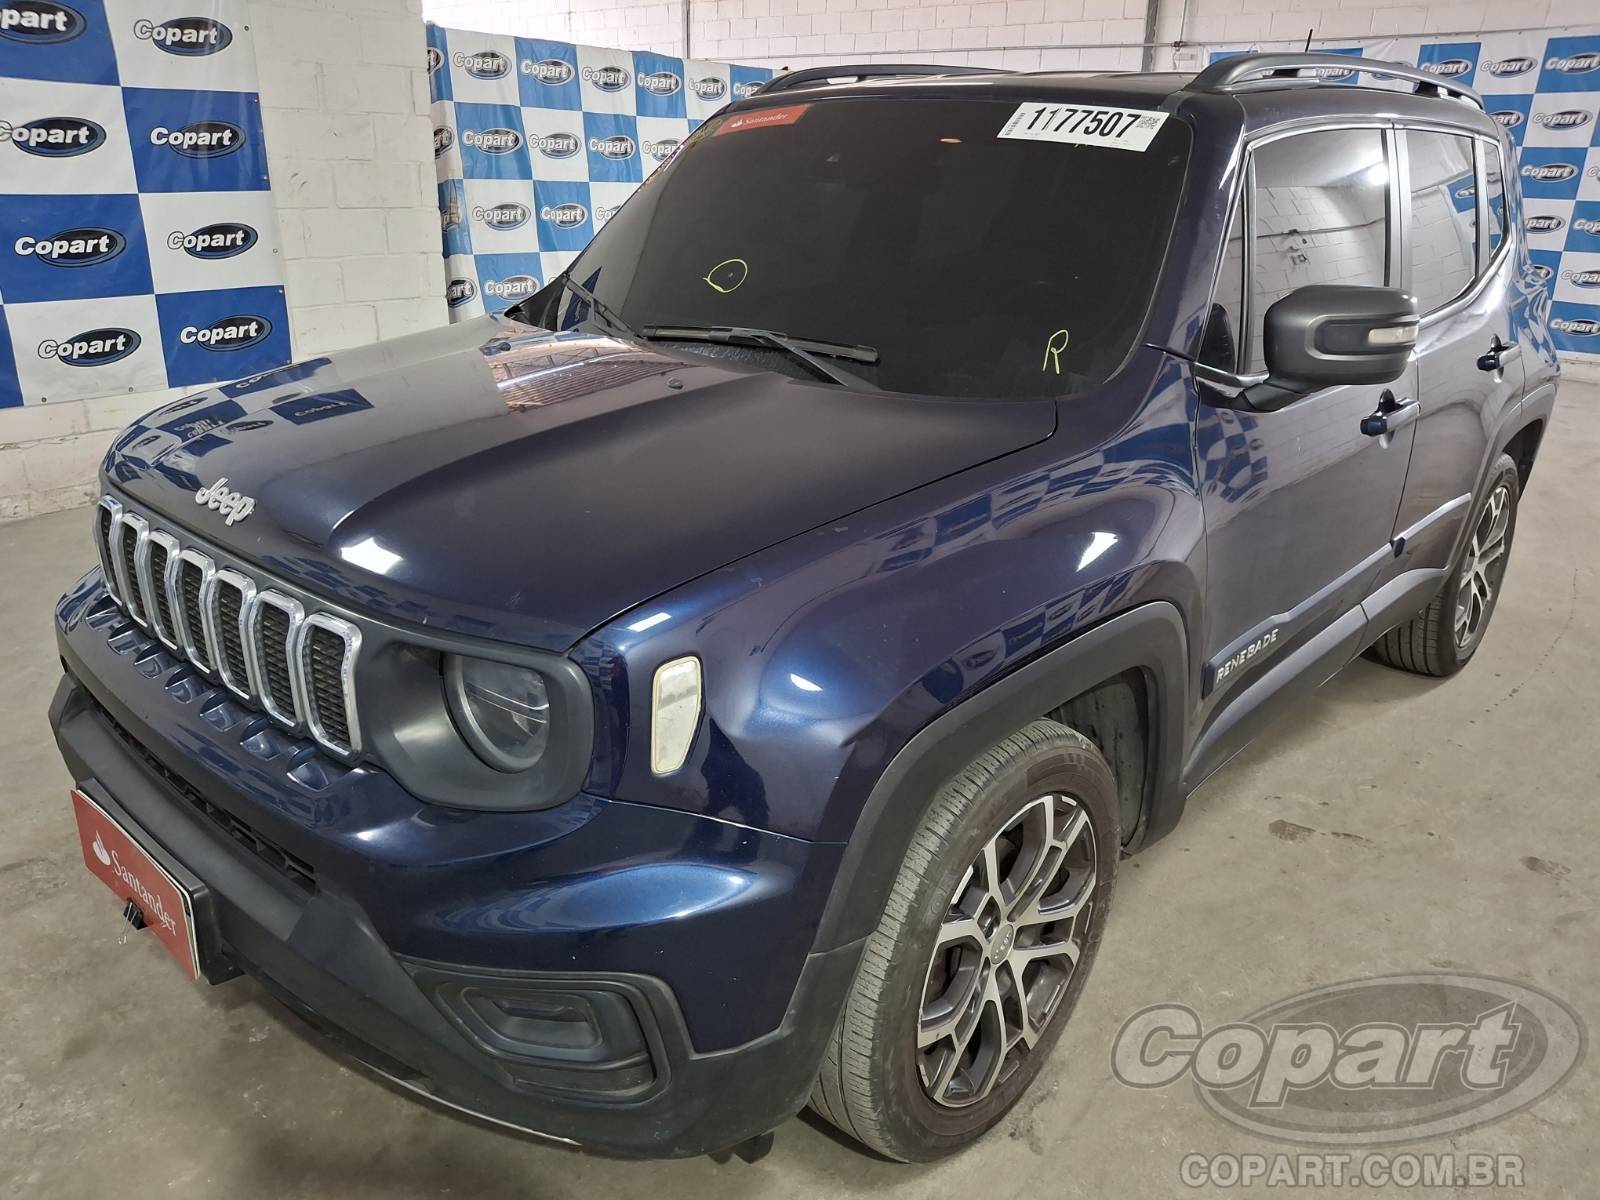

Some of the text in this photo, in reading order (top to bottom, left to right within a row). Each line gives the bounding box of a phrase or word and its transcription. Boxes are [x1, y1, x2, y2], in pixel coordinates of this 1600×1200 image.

[0, 7, 67, 31] part
[134, 19, 219, 45] Copart
[453, 51, 506, 73] Copart
[521, 59, 569, 80] Copart
[1480, 60, 1530, 74] Copart
[1545, 54, 1600, 71] Copart
[582, 67, 626, 85] Copart
[637, 72, 678, 91] Copart
[688, 79, 723, 96] Copart
[733, 82, 760, 97] Copa
[1027, 106, 1142, 138] 1177507
[1491, 113, 1520, 125] art
[1534, 112, 1585, 127] Copart
[0, 120, 91, 147] Copart
[150, 126, 233, 150] Copart
[463, 130, 516, 150] Copart
[529, 134, 576, 151] Copart
[589, 138, 633, 153] Copart
[642, 140, 679, 157] Copar
[1521, 164, 1572, 178] Copart
[472, 206, 524, 224] Copart
[541, 206, 582, 223] Copart
[1526, 218, 1558, 230] part
[1574, 218, 1600, 233] Cop
[14, 234, 110, 259] Copart
[167, 229, 245, 252] Copart
[1561, 270, 1600, 285] Copa
[448, 281, 472, 300] art
[484, 279, 534, 297] Copart
[180, 320, 259, 344] Copart
[1551, 318, 1600, 334] Copart
[38, 333, 126, 359] Copart
[195, 477, 256, 527] Jeep
[111, 850, 177, 937] Santander
